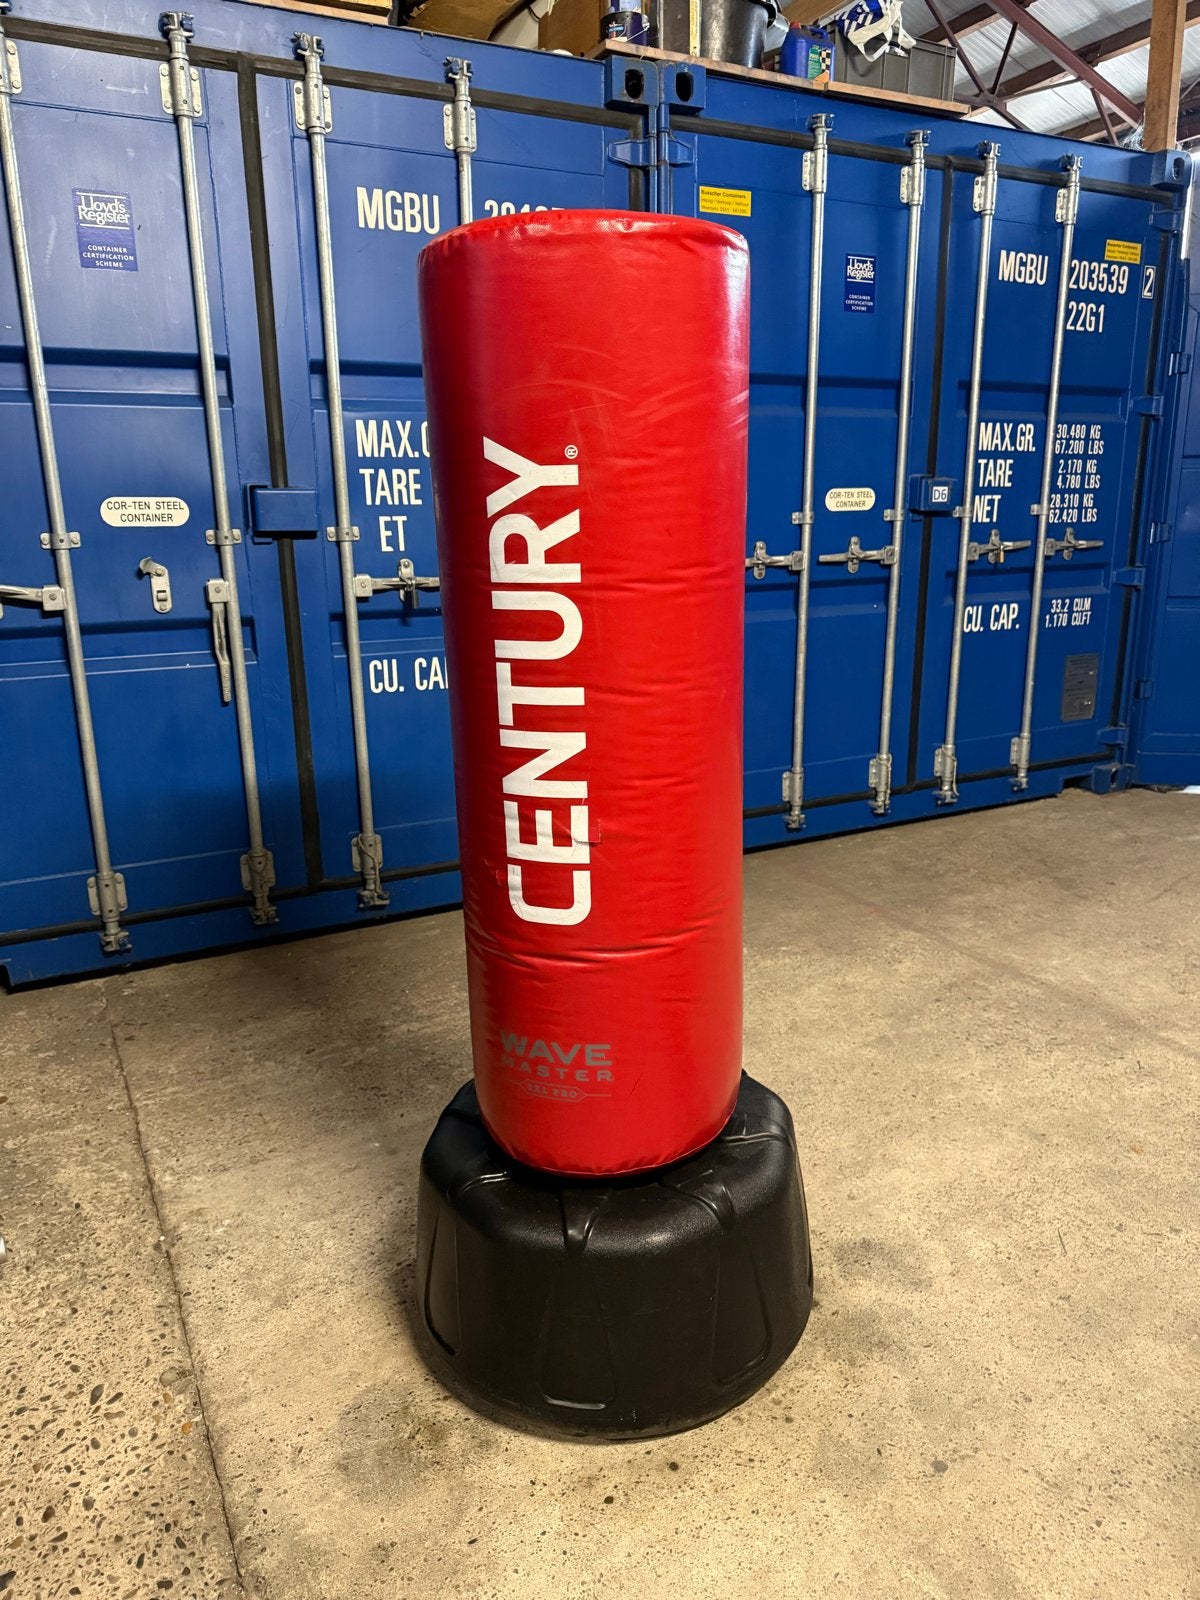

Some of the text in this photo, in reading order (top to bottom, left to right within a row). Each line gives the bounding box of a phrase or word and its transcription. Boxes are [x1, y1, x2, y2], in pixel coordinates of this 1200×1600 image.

[80, 195, 126, 213] Lloyd's
[357, 187, 440, 234] MGBU
[78, 205, 130, 225] Register
[82, 252, 134, 261] CERTIFICATION
[87, 245, 128, 253] CONTAINER
[95, 260, 123, 268] SCHEME
[850, 258, 873, 272] Lloyd's
[847, 265, 875, 280] Register
[998, 250, 1154, 297] MGBU 203539 2
[1066, 301, 1105, 333] 22G1
[1056, 424, 1086, 439] 30.480
[1089, 425, 1101, 439] KG
[1055, 440, 1104, 454] 67.200 LBS
[978, 459, 1097, 487] TARE 2.170 KG
[359, 468, 422, 505] TARE
[1056, 475, 1101, 488] 4.780 LBS
[829, 490, 873, 499] COR-TEN STEEL
[933, 488, 947, 501] D6
[106, 501, 184, 510] COR-TEN STEEL
[835, 500, 866, 508] CONTAINER
[972, 494, 1094, 523] NET 28.310 KG
[120, 513, 174, 522] CONTAINER
[1049, 508, 1098, 523] 62.420 LBS
[379, 516, 407, 552] ET
[963, 606, 984, 633] CU.
[990, 603, 1020, 631] CAP.
[1051, 598, 1069, 613] 33.2
[1045, 612, 1068, 628] 1.170
[369, 656, 449, 693] CU. CA
[501, 1030, 612, 1066] WAVE
[501, 1056, 613, 1082] MASTER
